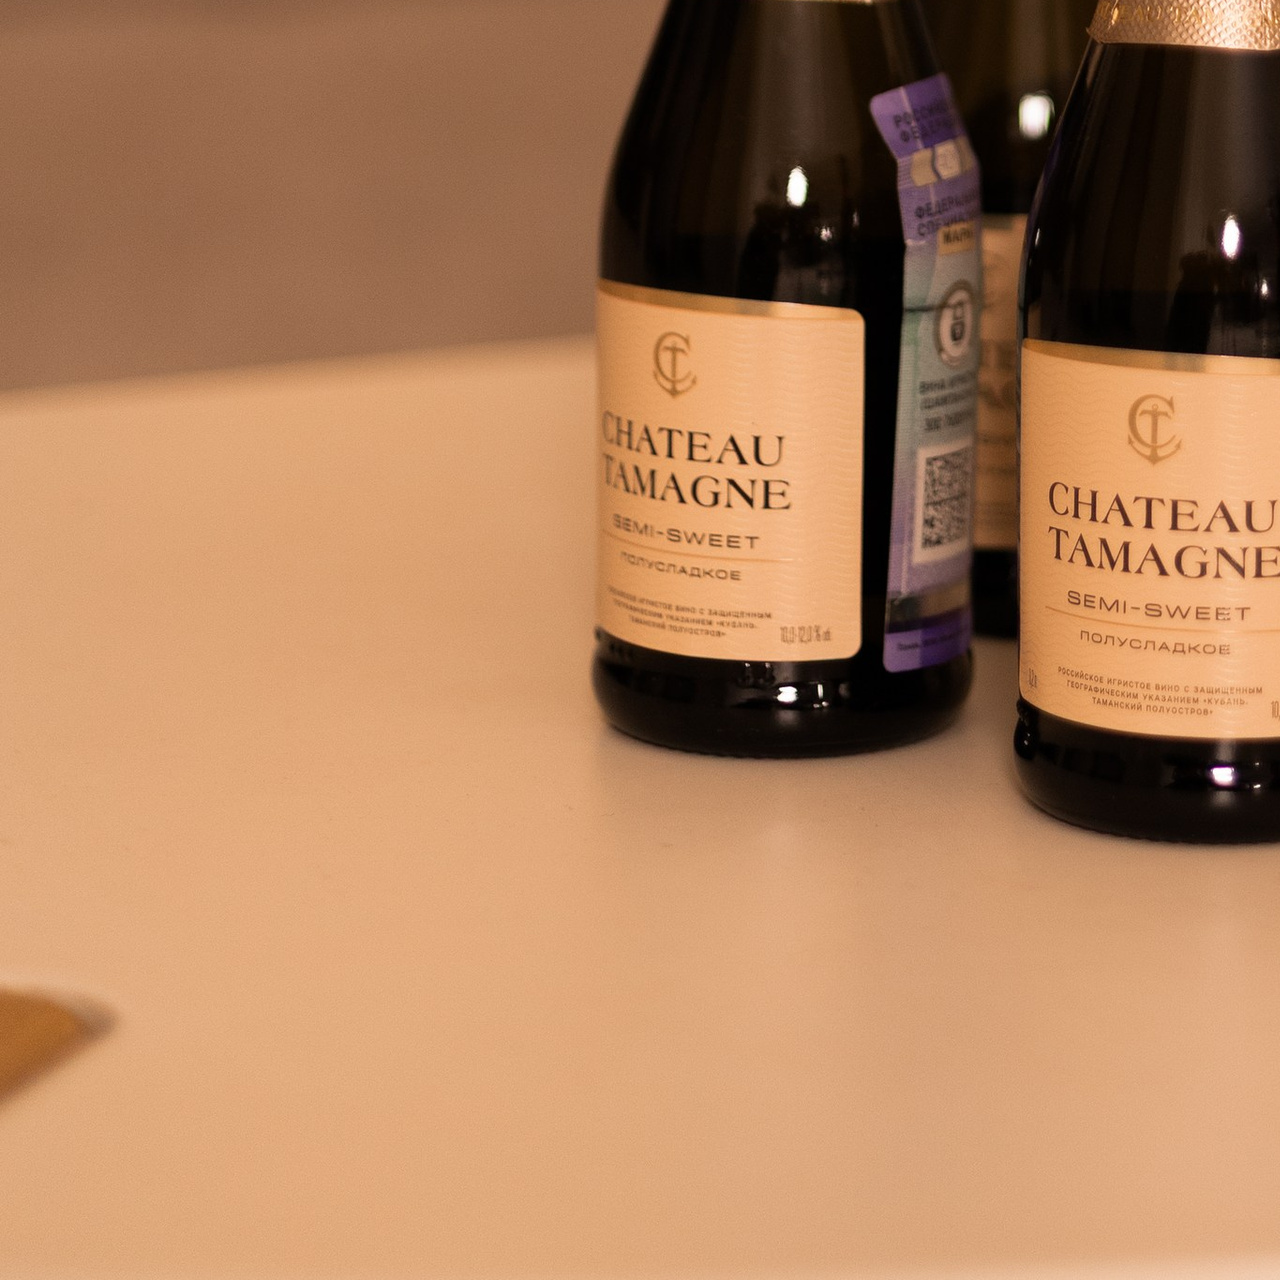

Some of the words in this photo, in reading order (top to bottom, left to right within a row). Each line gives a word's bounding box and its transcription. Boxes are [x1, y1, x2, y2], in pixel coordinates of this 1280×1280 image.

[602, 410, 785, 467] CHATEAU
[603, 453, 792, 510] TAMAGNE
[1048, 481, 1278, 533] CHATEAU
[613, 513, 760, 549] SEMI-SWEET
[621, 551, 742, 581] ПОЛУСЛАДКОЕ
[1067, 590, 1251, 621] SEMI-SWEET
[1080, 630, 1231, 655] ПОЛУСЛАДКОЕ
[1058, 666, 1104, 684] РОССИЙСКОЕ
[1107, 677, 1151, 690] ИГРИСТОЕ
[1155, 683, 1179, 692] ВИНО
[1184, 685, 1190, 693] С
[1194, 686, 1263, 695] ЗАЩИЩЕННЫМ
[1067, 679, 1139, 699] ГЕОГРАФИЧЕСКИМ
[1142, 692, 1199, 704] УКАЗАНИЕМ
[1092, 696, 1143, 711] ТАМАНСКИЙ
